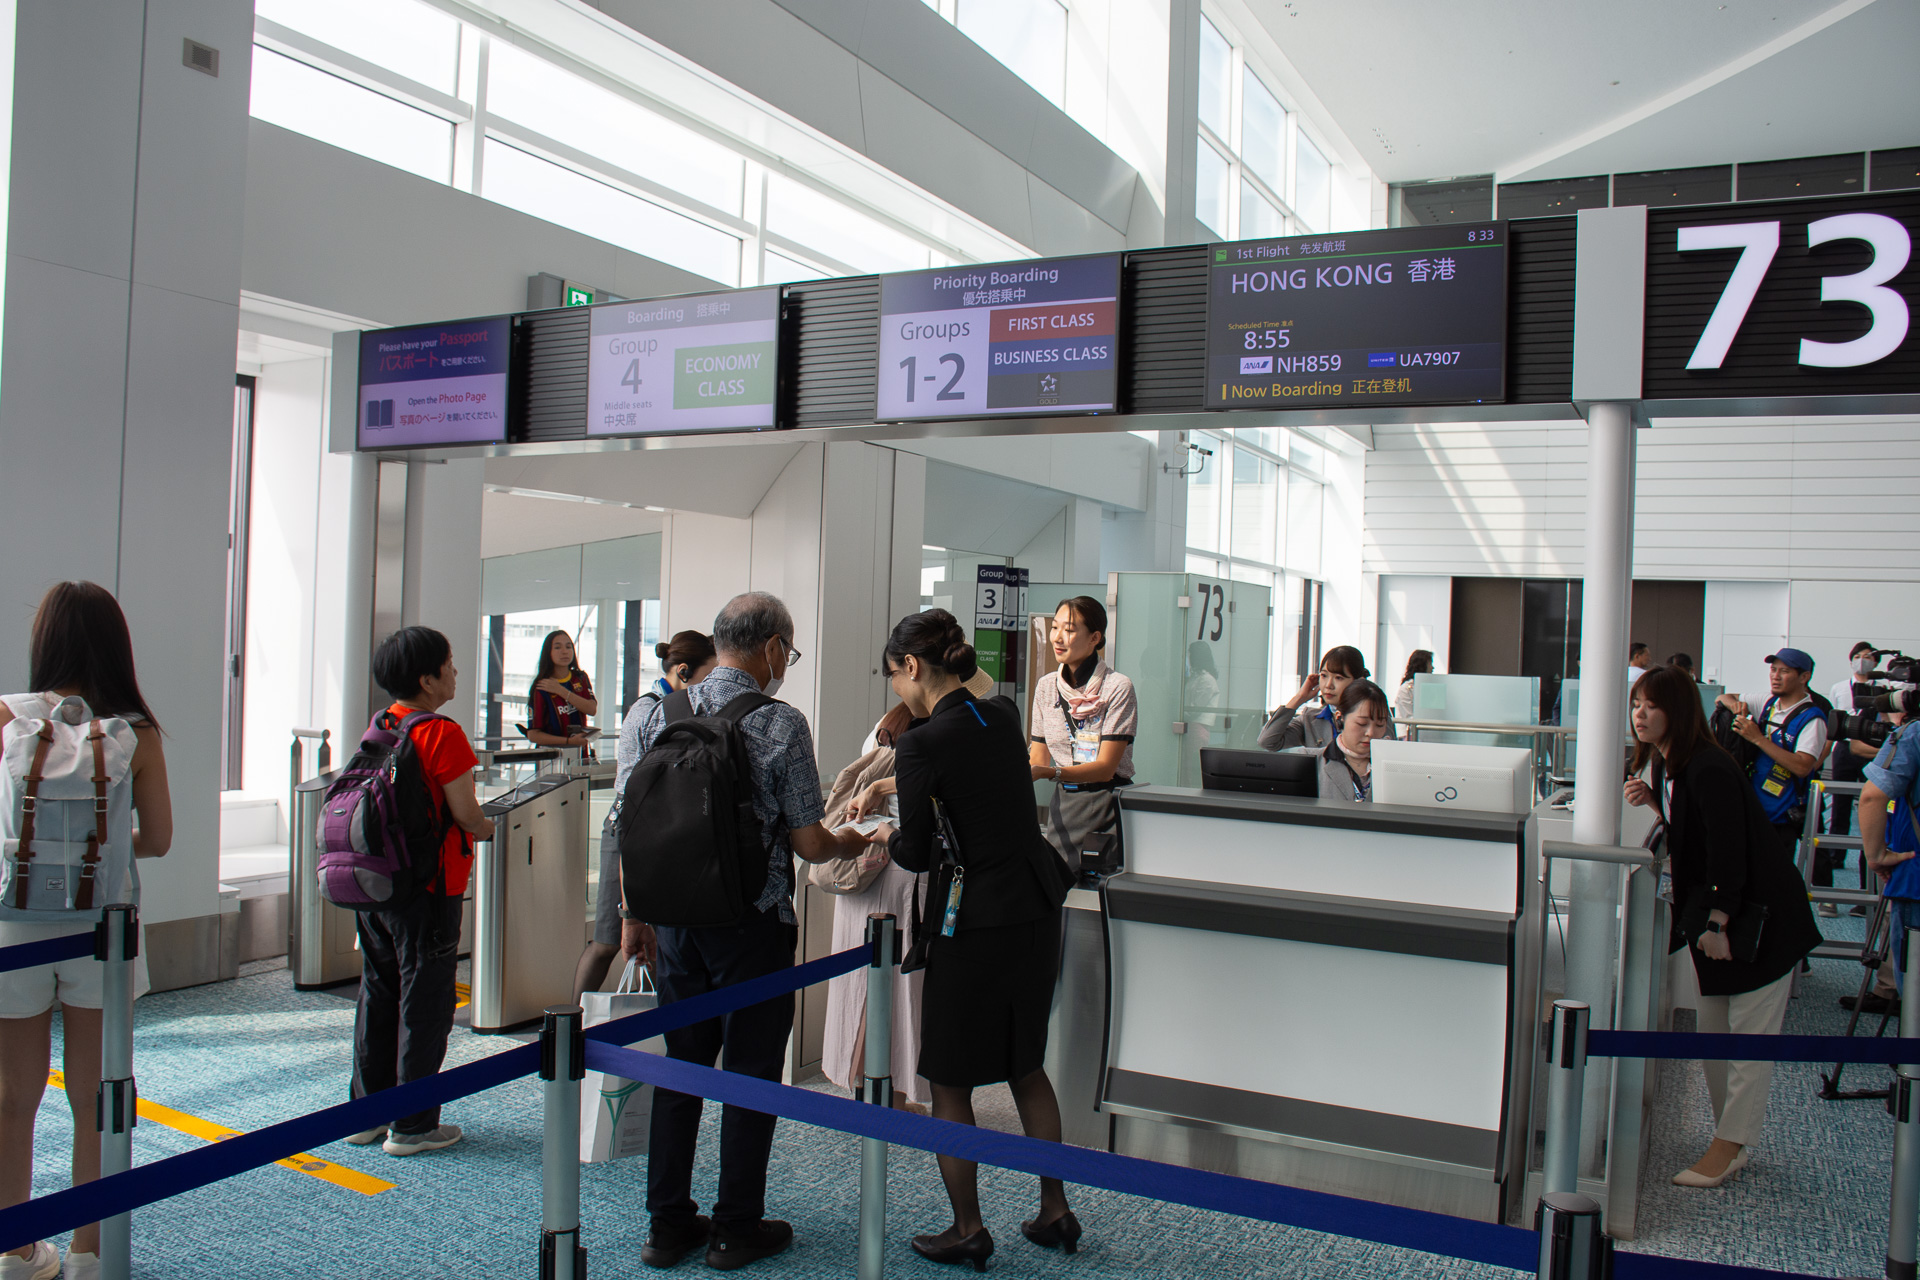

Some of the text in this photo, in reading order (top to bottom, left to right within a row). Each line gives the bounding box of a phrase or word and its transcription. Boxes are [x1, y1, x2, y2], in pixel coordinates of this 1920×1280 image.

[1237, 246, 1290, 260] 1st Flight
[1300, 240, 1346, 255] 先发航班
[933, 268, 1059, 290] Priority Boarding
[1232, 263, 1393, 294] HONG KONG
[1408, 257, 1456, 283] 香港
[962, 288, 1026, 306] 優先搭乗中
[1677, 212, 1912, 368] 73
[627, 308, 684, 324] Boarding
[696, 302, 731, 318] 搭乗中
[1008, 313, 1095, 331] FIRST CLASS
[1228, 322, 1262, 330] Scheduled
[900, 321, 970, 342] Groups
[1244, 329, 1290, 350] 8:55
[378, 330, 488, 352] Please have your Passport
[609, 337, 658, 357] Group
[685, 354, 761, 374] ECONOMY
[994, 346, 1107, 366] BUSINESS CLASS
[1278, 354, 1342, 373] NH859
[1400, 352, 1460, 367] UA7907
[620, 358, 643, 395] 4
[899, 353, 965, 403] 1-2
[698, 380, 745, 398] CLASS
[1232, 381, 1342, 398] Now Boarding
[1352, 378, 1412, 394] 正在登机
[408, 392, 486, 407] Open the Photo Page
[604, 399, 652, 410] Middle seats
[604, 413, 637, 427] 中央席
[980, 569, 1004, 579] Group
[983, 589, 996, 609] 3
[1197, 583, 1224, 642] 73
